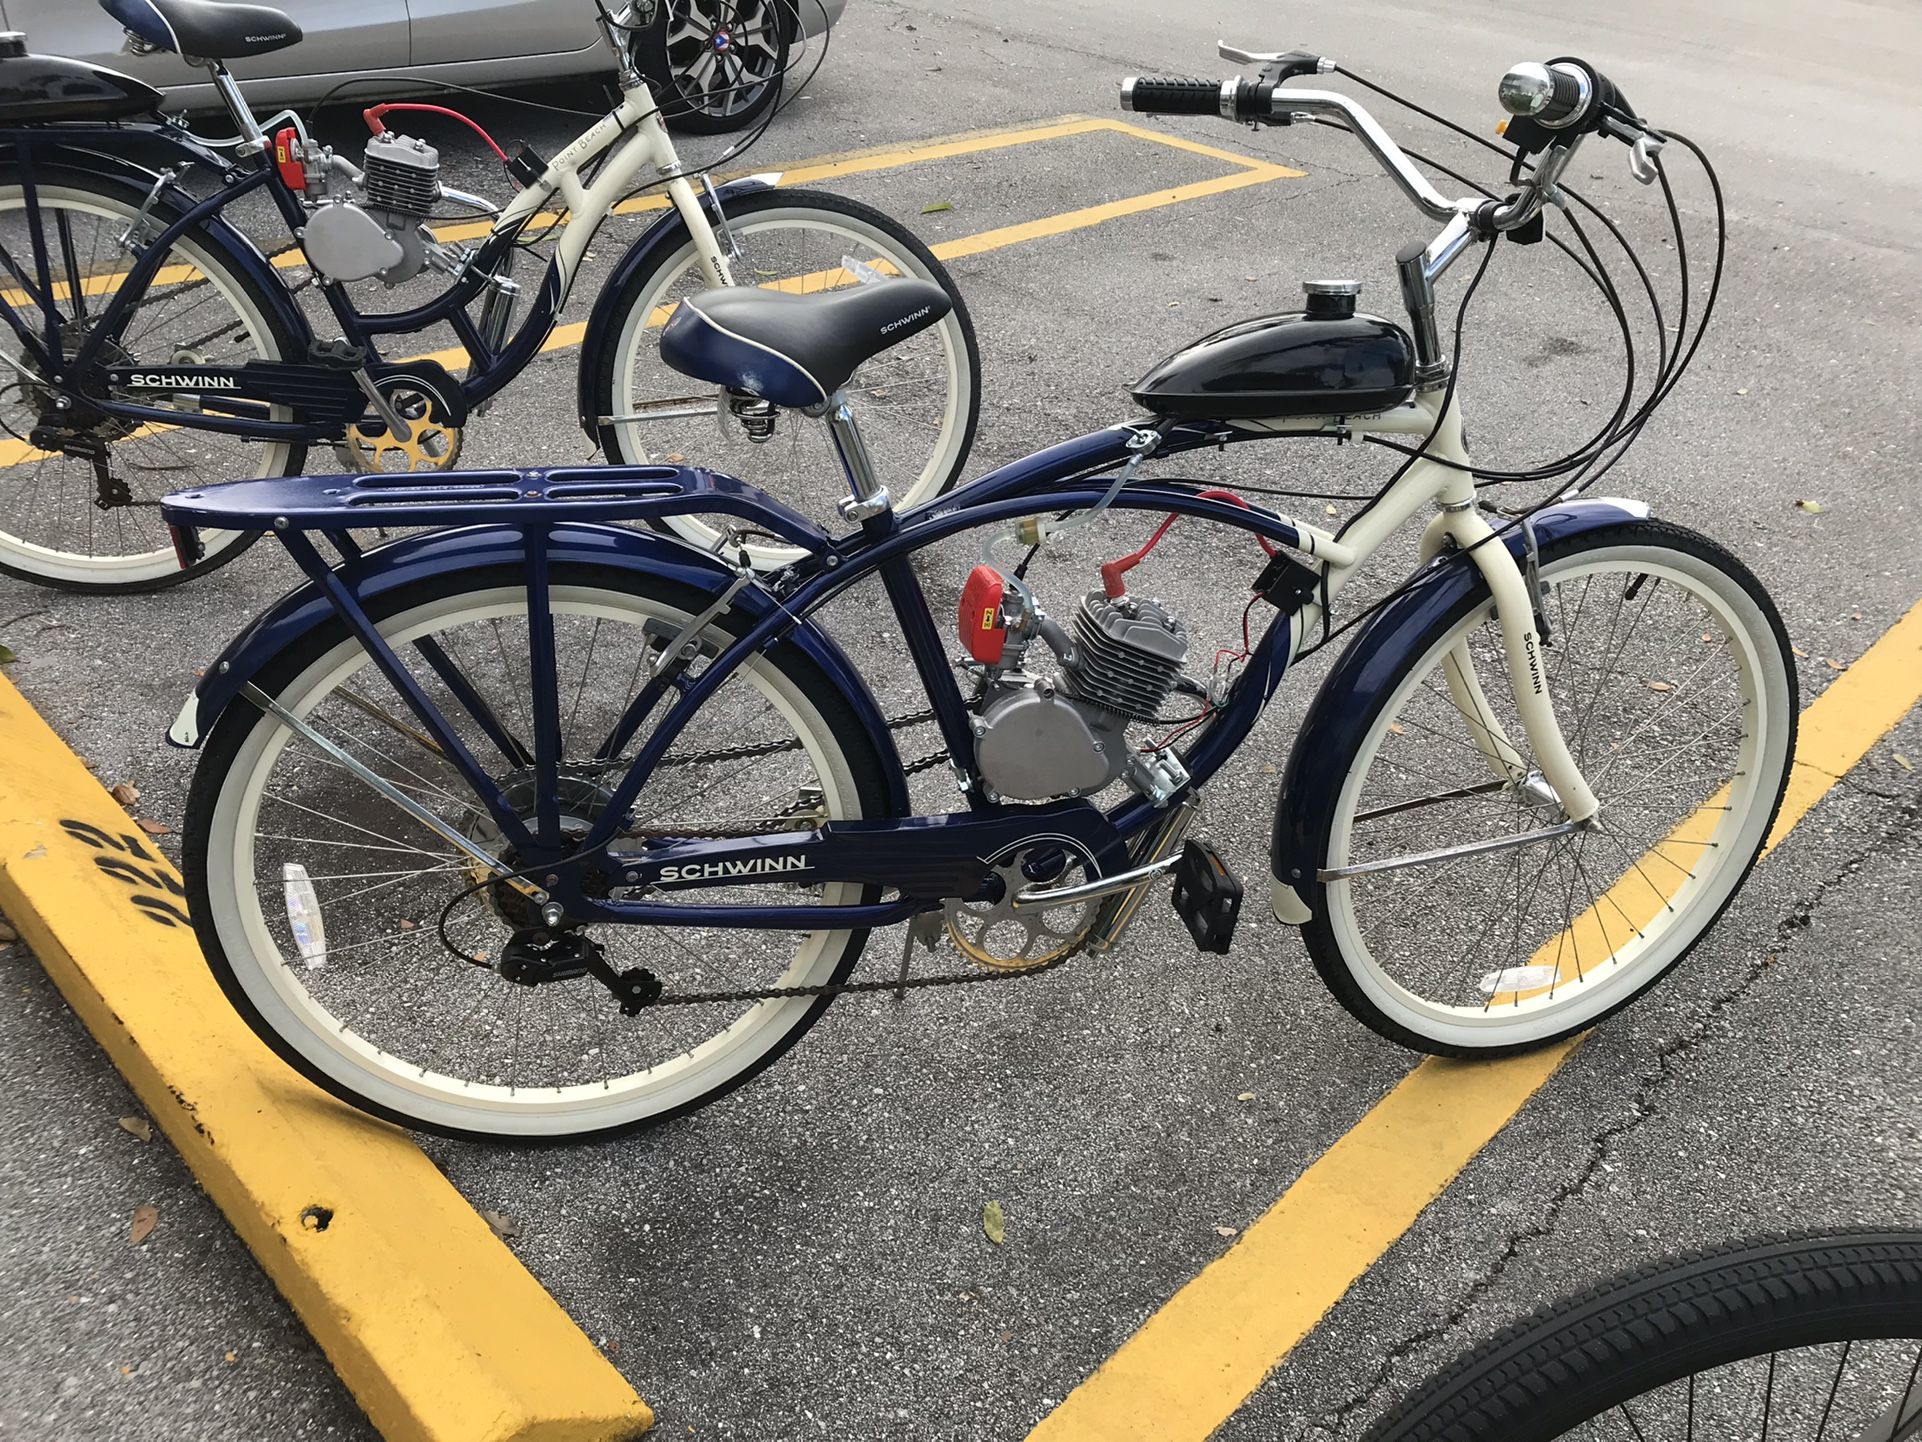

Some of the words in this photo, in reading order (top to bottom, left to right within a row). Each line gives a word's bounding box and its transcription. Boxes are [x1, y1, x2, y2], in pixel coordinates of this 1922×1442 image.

[244, 34, 284, 43] SCHWINN
[551, 147, 579, 171] POINT
[578, 123, 607, 150] BEACH
[710, 255, 729, 287] SCHW
[880, 306, 929, 335] SCHWINN
[130, 374, 234, 388] SCHWINN
[1523, 632, 1543, 695] SCHWINN
[659, 855, 806, 881] SCHWINN
